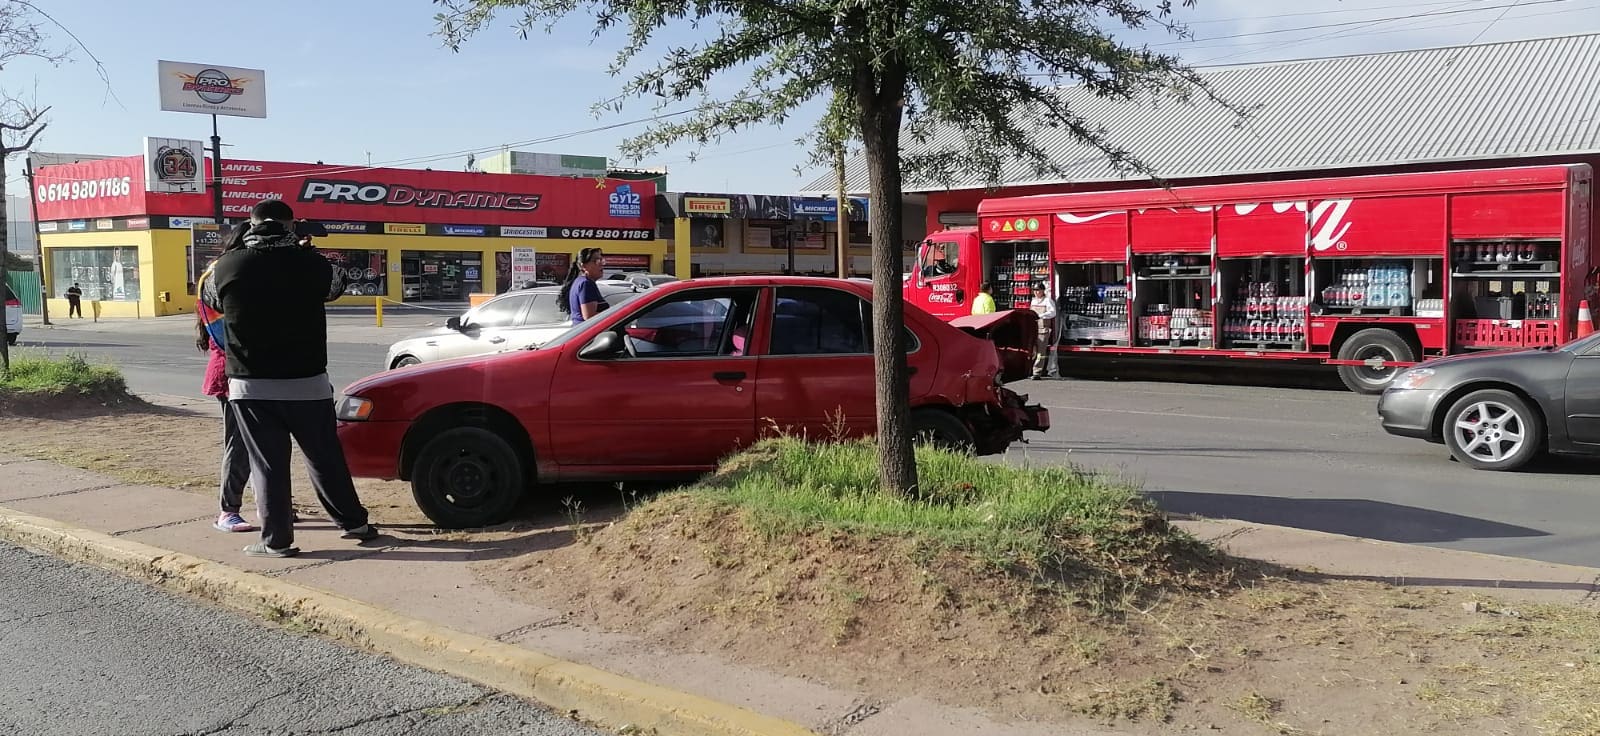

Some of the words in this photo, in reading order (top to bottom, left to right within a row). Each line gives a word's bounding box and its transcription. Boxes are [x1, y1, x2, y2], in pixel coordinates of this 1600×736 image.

[199, 77, 229, 86] PRO
[163, 156, 193, 176] 34
[220, 164, 263, 172] LANTAS
[221, 177, 248, 185] INES
[48, 182, 70, 201] 614
[71, 180, 97, 200] 980
[100, 176, 130, 198] 1186
[222, 191, 283, 200] LINEACIÓN
[689, 200, 726, 211] PIRELLI
[323, 223, 366, 231] OODYEAR
[388, 224, 421, 233] PIRELLI
[503, 227, 545, 236] BRIDGESTONE
[571, 229, 593, 238] 614
[595, 229, 620, 238] 980
[622, 230, 649, 239] 1186
